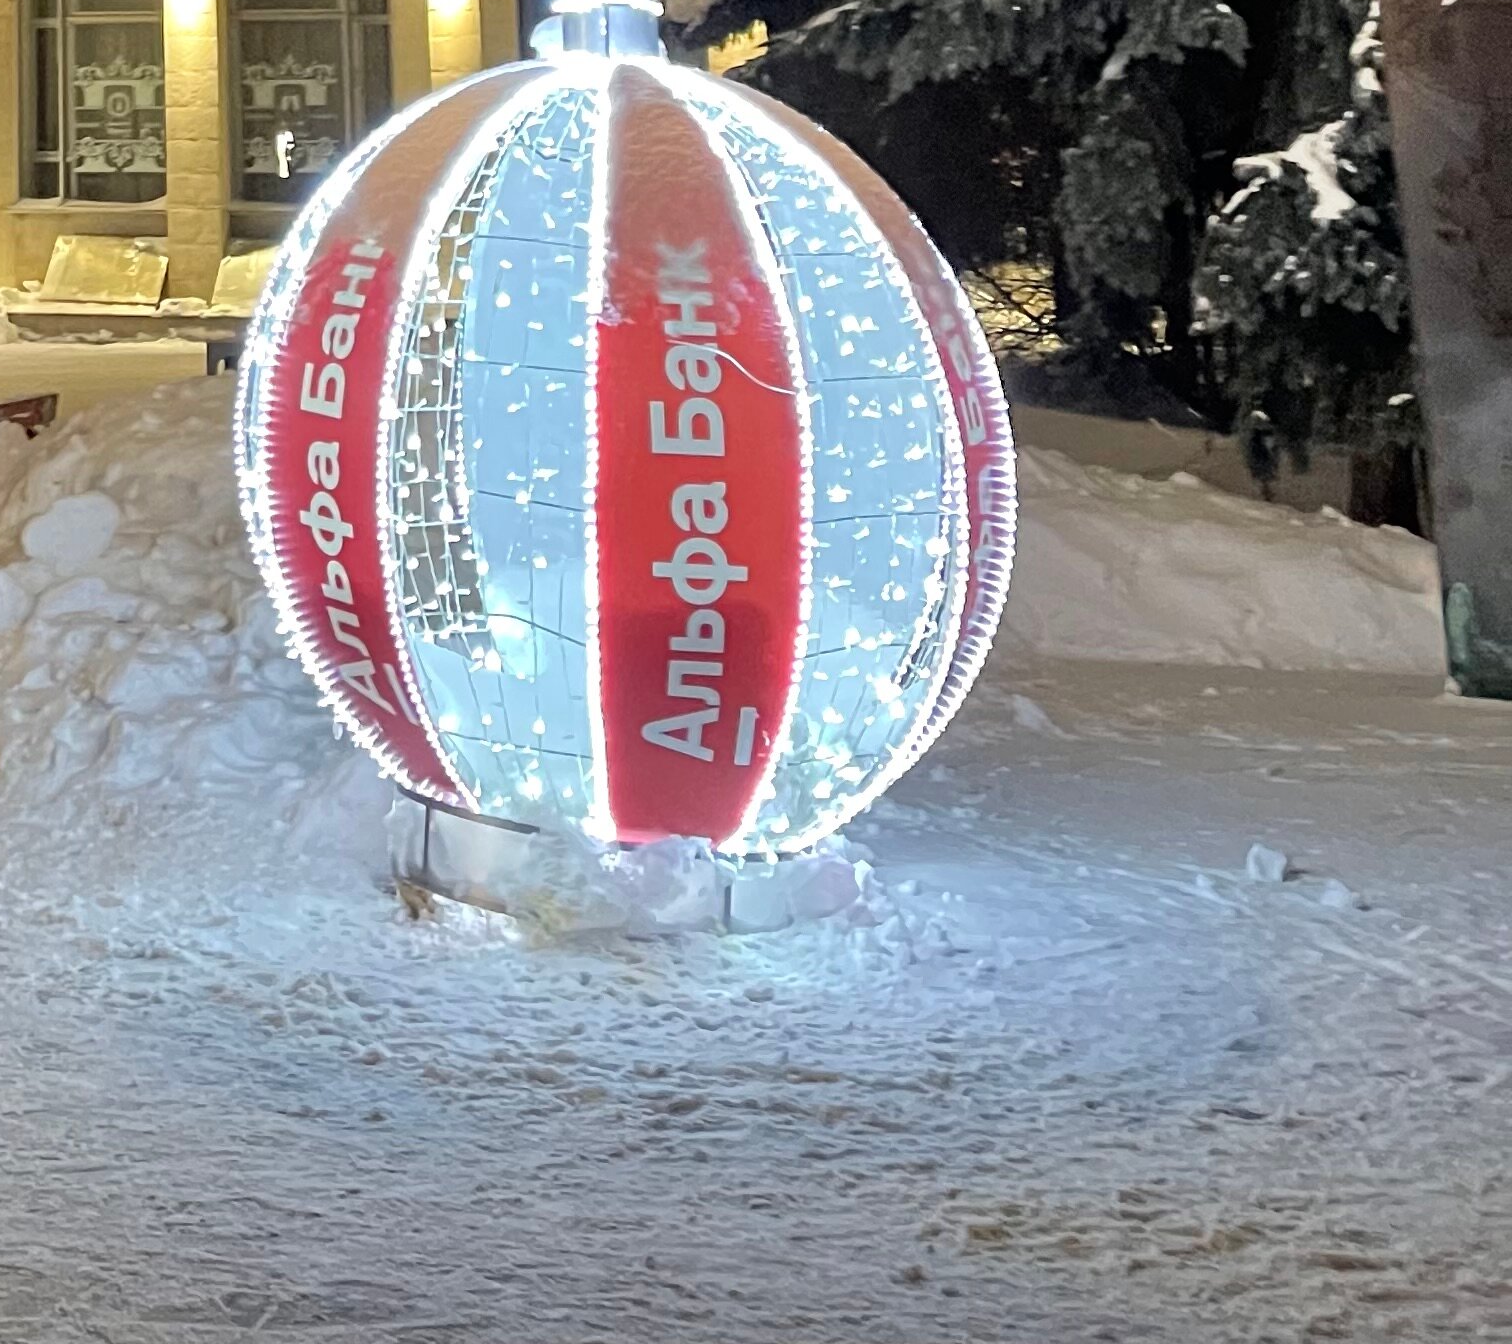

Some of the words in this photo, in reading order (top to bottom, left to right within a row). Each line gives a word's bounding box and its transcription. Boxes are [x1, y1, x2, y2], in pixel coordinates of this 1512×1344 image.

[649, 237, 726, 457] Банк
[299, 440, 400, 717] Альфа
[641, 481, 754, 764] Альфа
